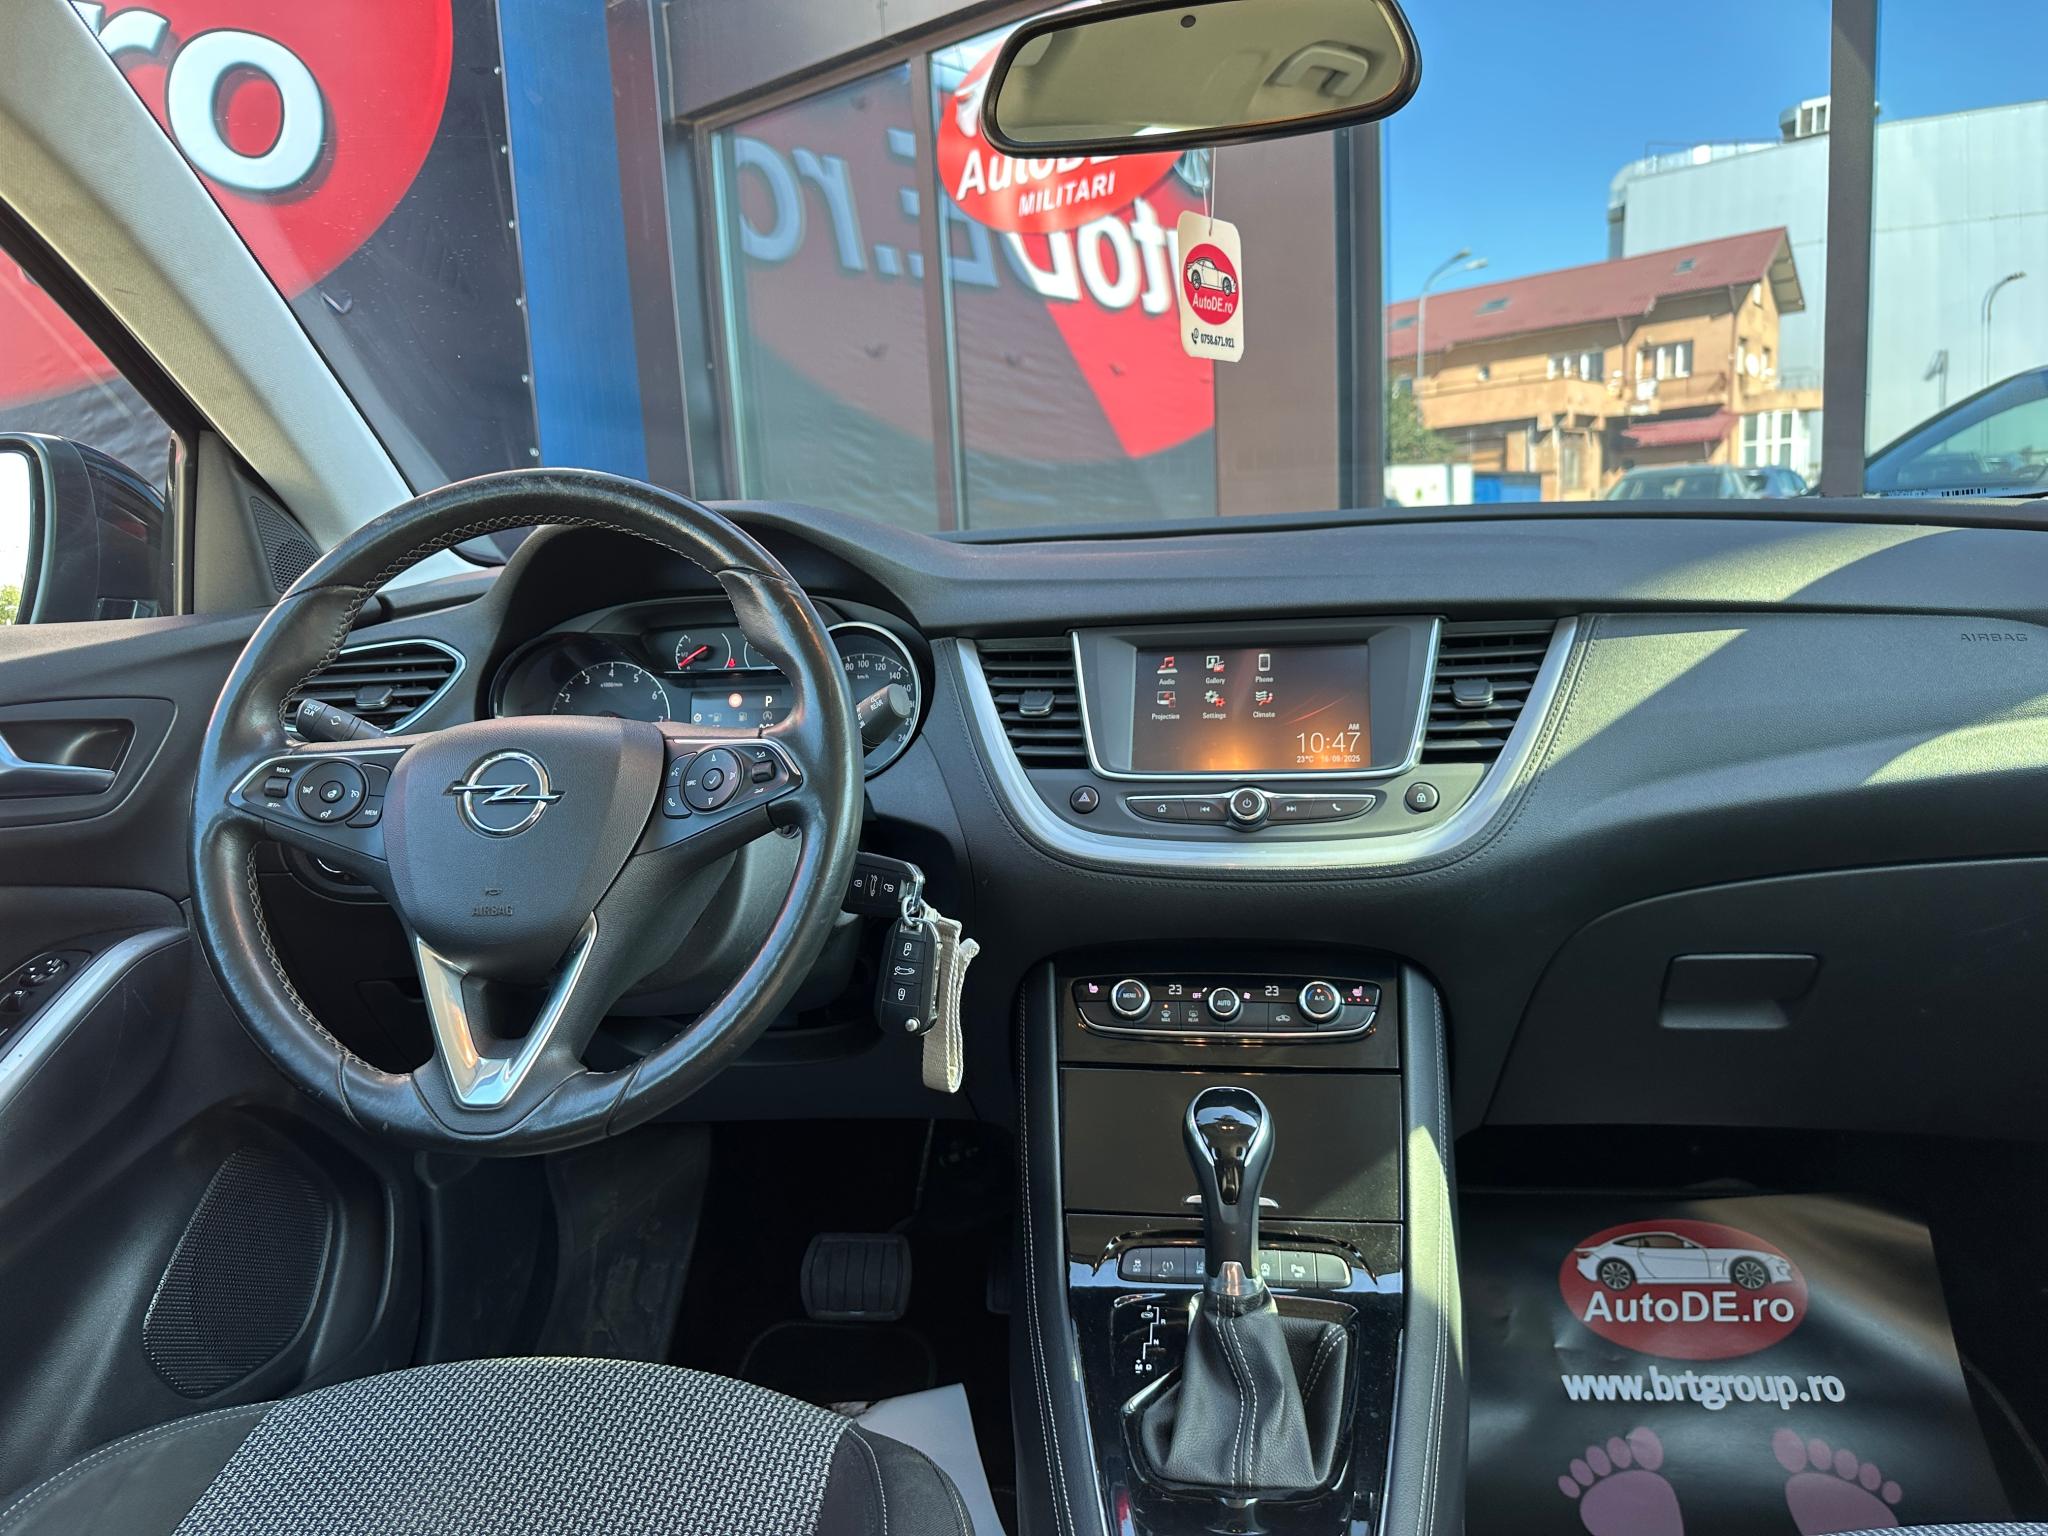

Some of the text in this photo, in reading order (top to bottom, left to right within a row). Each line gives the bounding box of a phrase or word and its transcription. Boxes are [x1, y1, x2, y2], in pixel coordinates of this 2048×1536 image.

[1018, 171, 1116, 217] MILITARI
[1192, 292, 1233, 314] AutoDE.ro
[1961, 633, 2028, 642] AIRBAG
[845, 662, 855, 671] 80
[857, 660, 870, 668] 100
[874, 663, 887, 671] 120
[608, 669, 615, 678] 4
[889, 671, 901, 680] 140
[584, 675, 591, 684] 3
[633, 674, 640, 683] 5
[1205, 677, 1225, 685] Gallery
[564, 694, 571, 703] 2
[651, 691, 658, 700] 6
[765, 695, 773, 707] P
[1297, 732, 1361, 753] 10:47
[364, 808, 378, 816] MEM
[472, 905, 513, 917] AIRBAG
[1168, 984, 1182, 995] 23
[1265, 985, 1279, 996] 23
[1584, 1290, 1796, 1323] AutoDE.ro
[1561, 1366, 1846, 1410] www.brtgroup.ro
